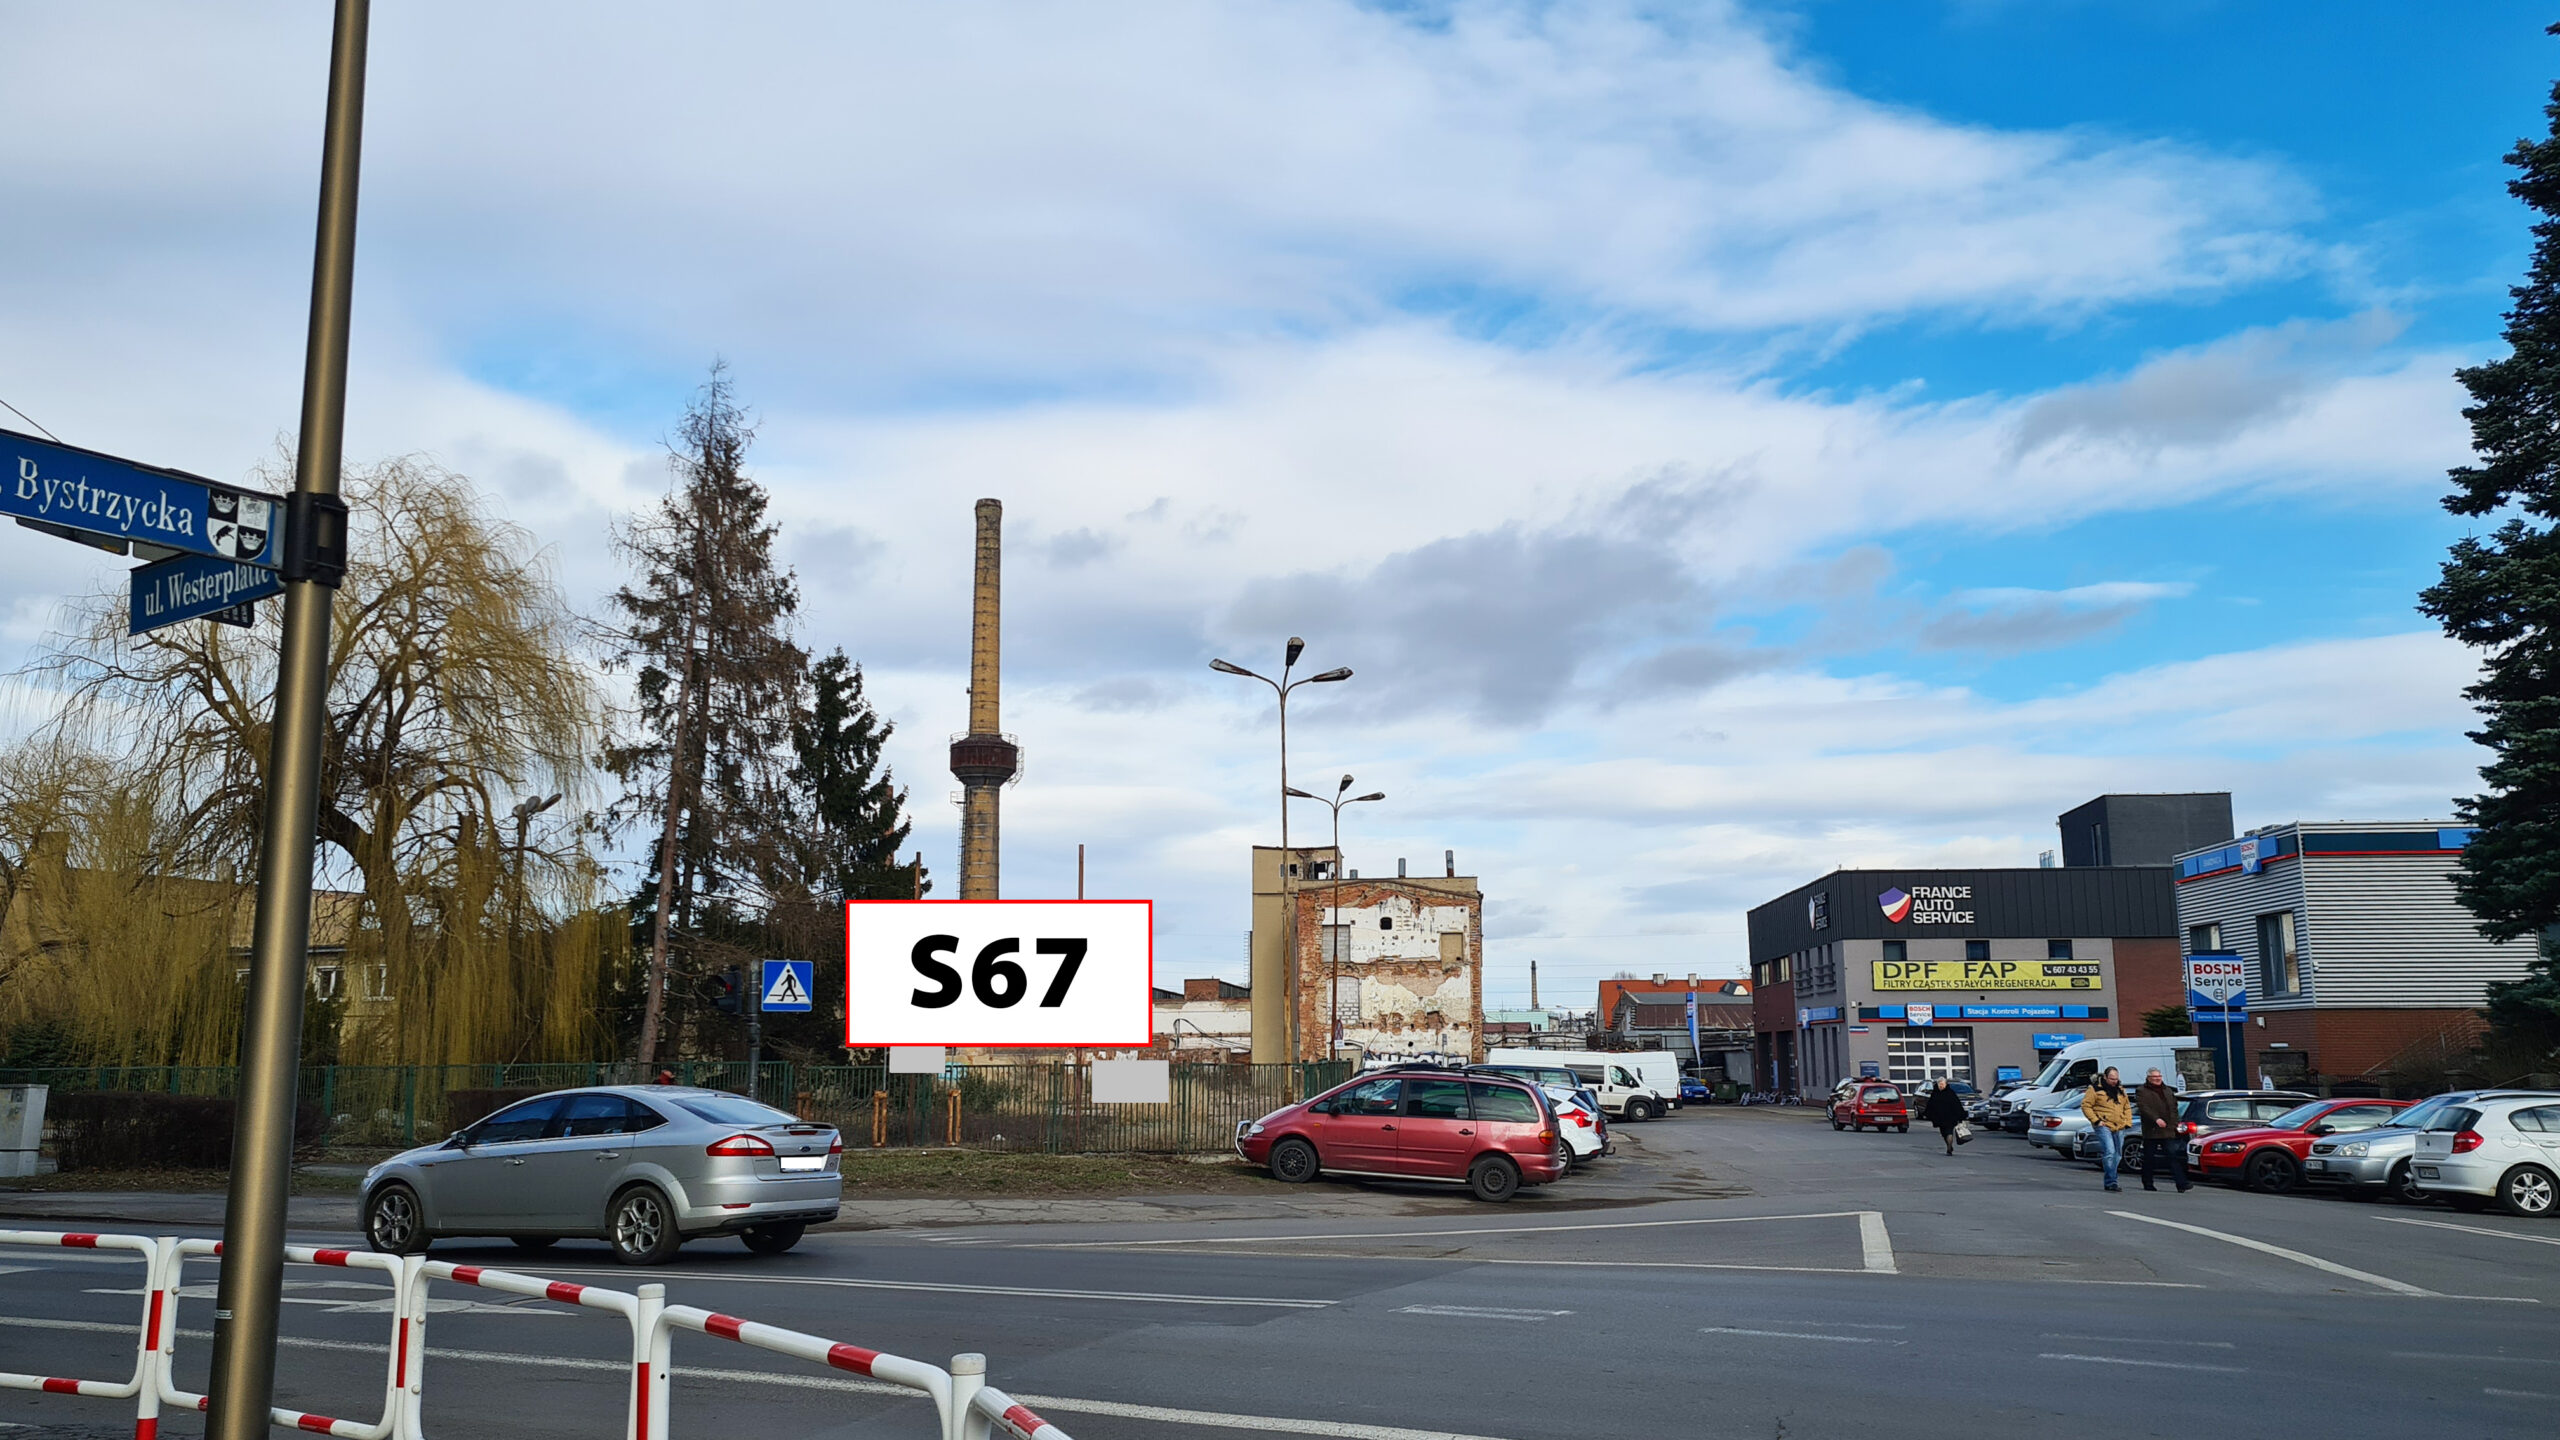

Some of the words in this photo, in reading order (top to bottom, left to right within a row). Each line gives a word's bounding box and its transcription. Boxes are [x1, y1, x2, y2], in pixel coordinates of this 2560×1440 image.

[14, 455, 195, 537] Bystrzycka
[144, 578, 165, 617] ul.
[168, 563, 270, 610] Westerplatte
[1911, 886, 1972, 899] FRANCE
[1912, 899, 1955, 911] AUTO
[1912, 911, 1975, 924] SERVICE
[1882, 962, 1939, 979] DPF
[1963, 962, 2018, 979] FAP
[2052, 965, 2066, 974] 607
[2067, 965, 2077, 974] 43
[2078, 965, 2088, 974] 43
[2088, 965, 2099, 974] 55
[2193, 963, 2242, 975] BOSCH
[1883, 979, 1911, 989] FILTRY
[1913, 979, 1952, 990] CZĄSTEK
[1953, 979, 1992, 988] STAŁYCH
[1994, 979, 2057, 989] REGENERACJA
[2194, 976, 2243, 987] Servce
[1967, 1007, 1989, 1016] Stacja
[1991, 1007, 2020, 1015] Kontroli
[2021, 1007, 2056, 1016] Pojazdów
